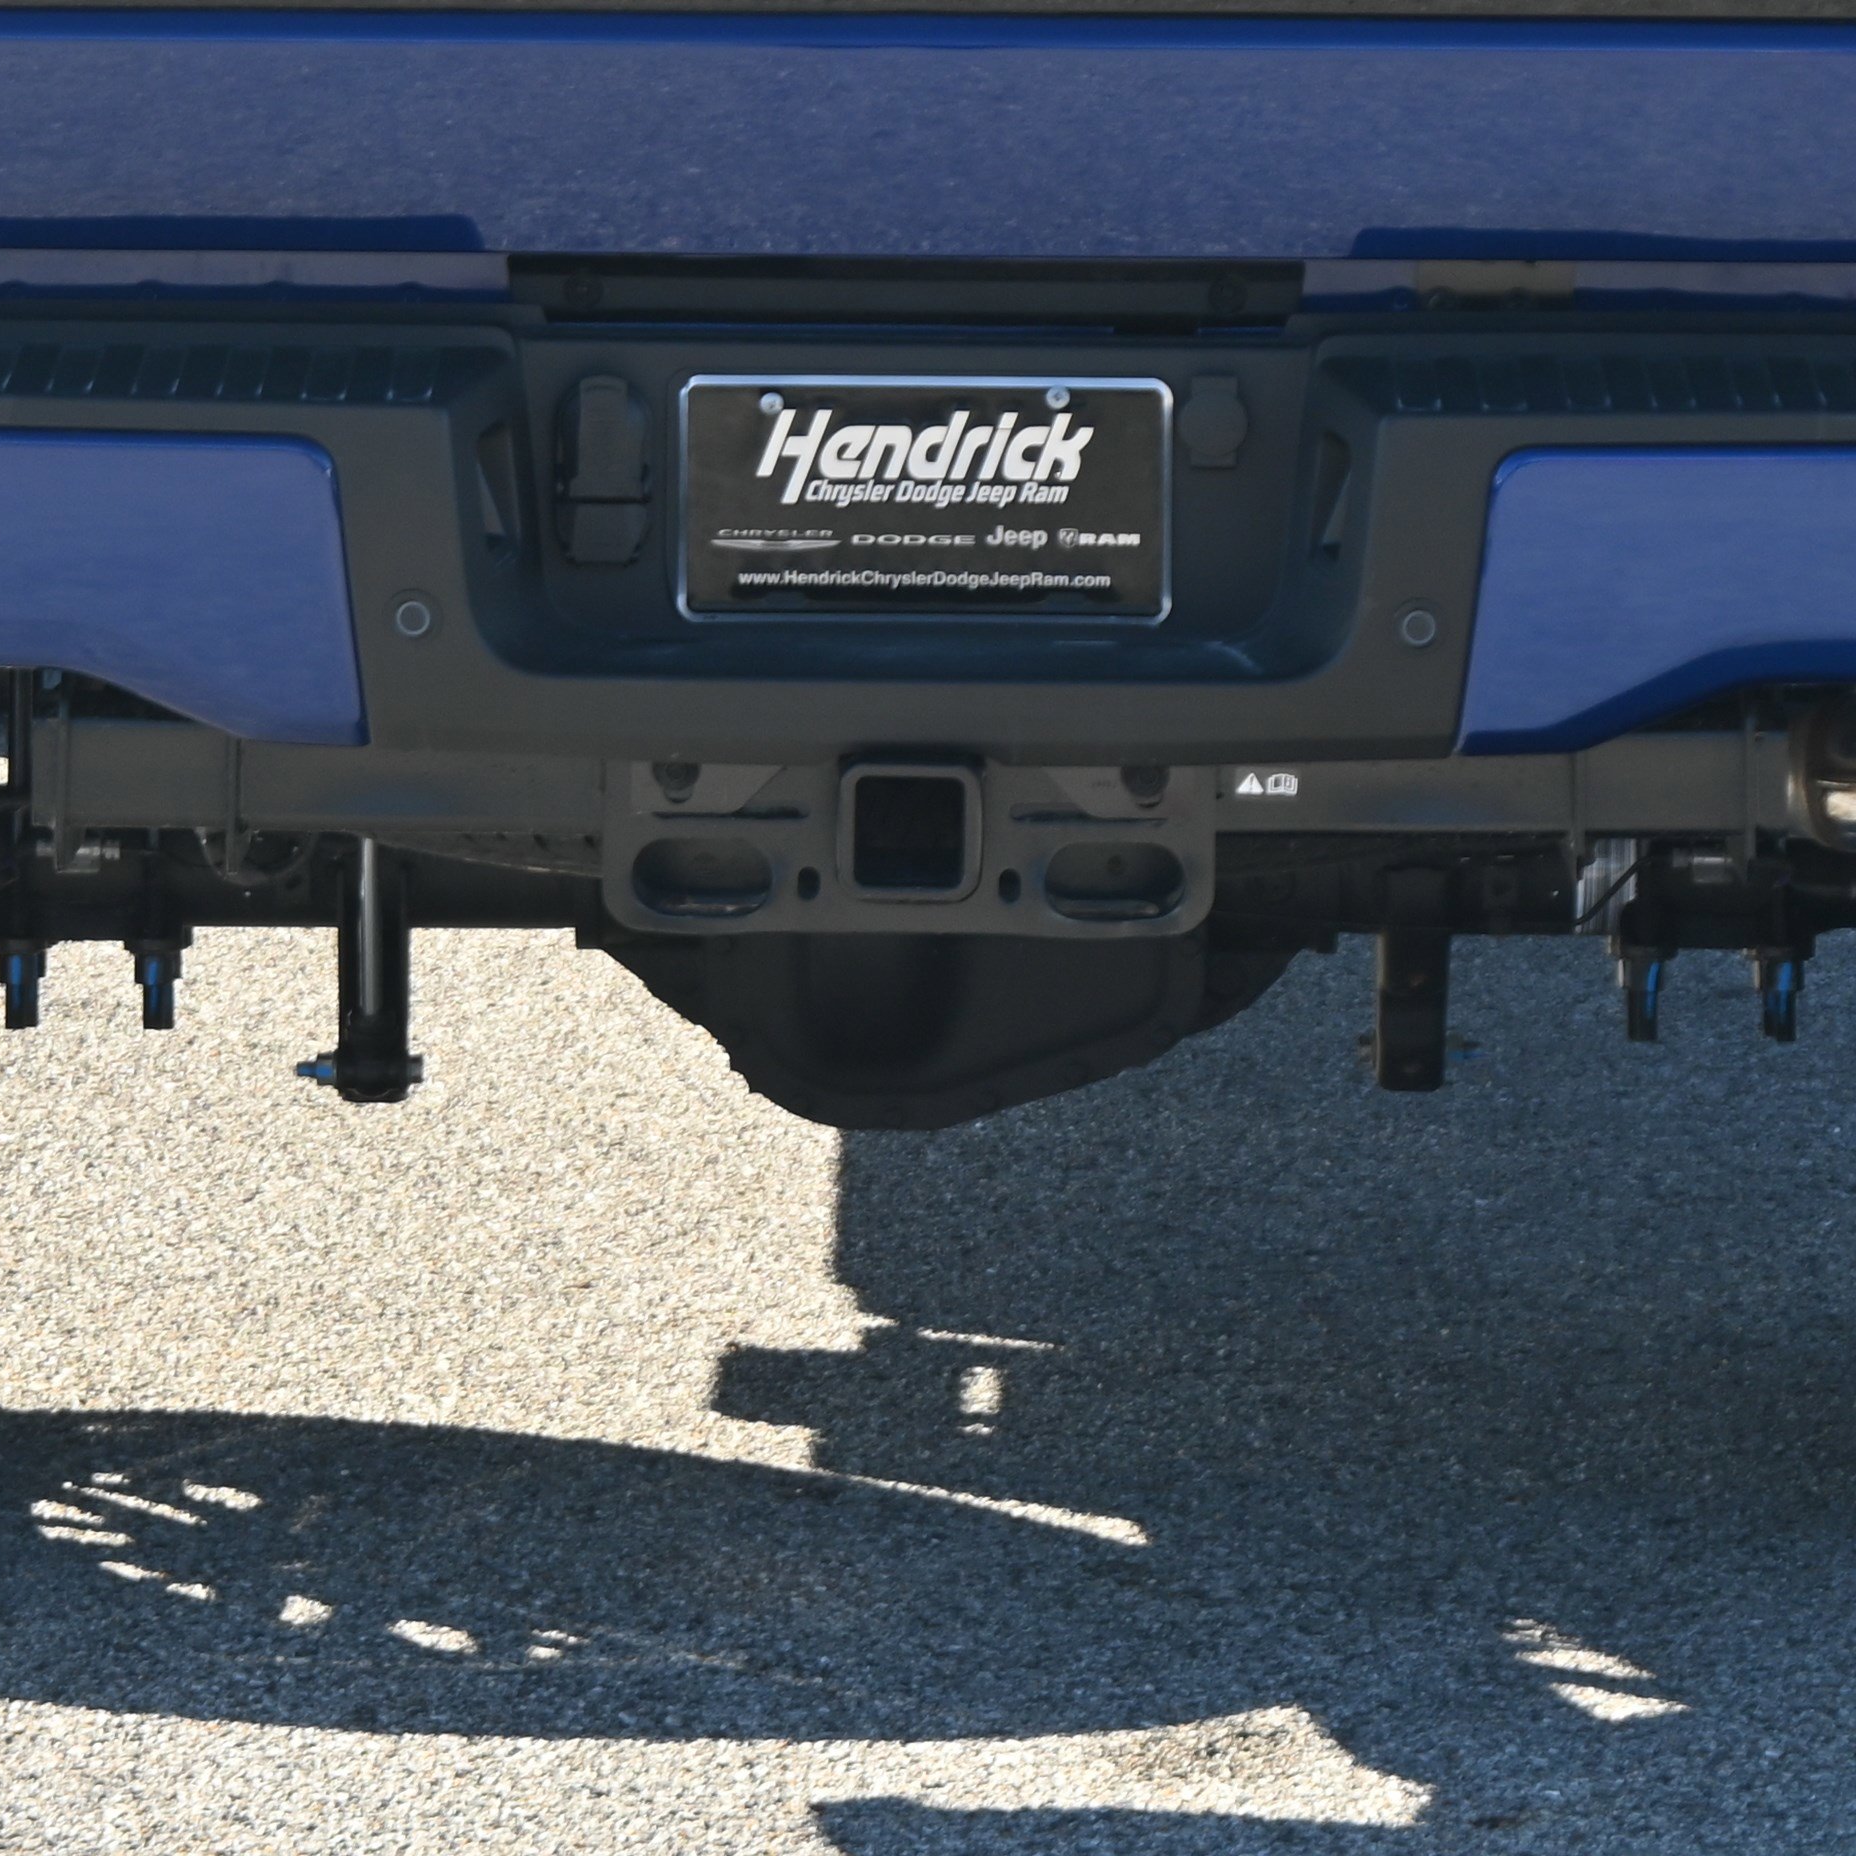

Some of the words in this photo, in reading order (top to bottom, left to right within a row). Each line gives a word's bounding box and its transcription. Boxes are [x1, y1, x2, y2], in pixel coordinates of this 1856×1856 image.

[756, 408, 1094, 505] Hendrick
[804, 479, 895, 509] Chrysler
[895, 479, 966, 509] Dodge
[965, 481, 1017, 509] Jeep
[1018, 481, 1070, 504] Ram
[717, 528, 834, 538] CHRYSLER
[850, 533, 976, 546] DODGE
[986, 525, 1049, 550] Jeep
[1077, 532, 1141, 547] RAM
[738, 569, 1112, 590] www.HendrickChryslerDodgeJeepRam.com
